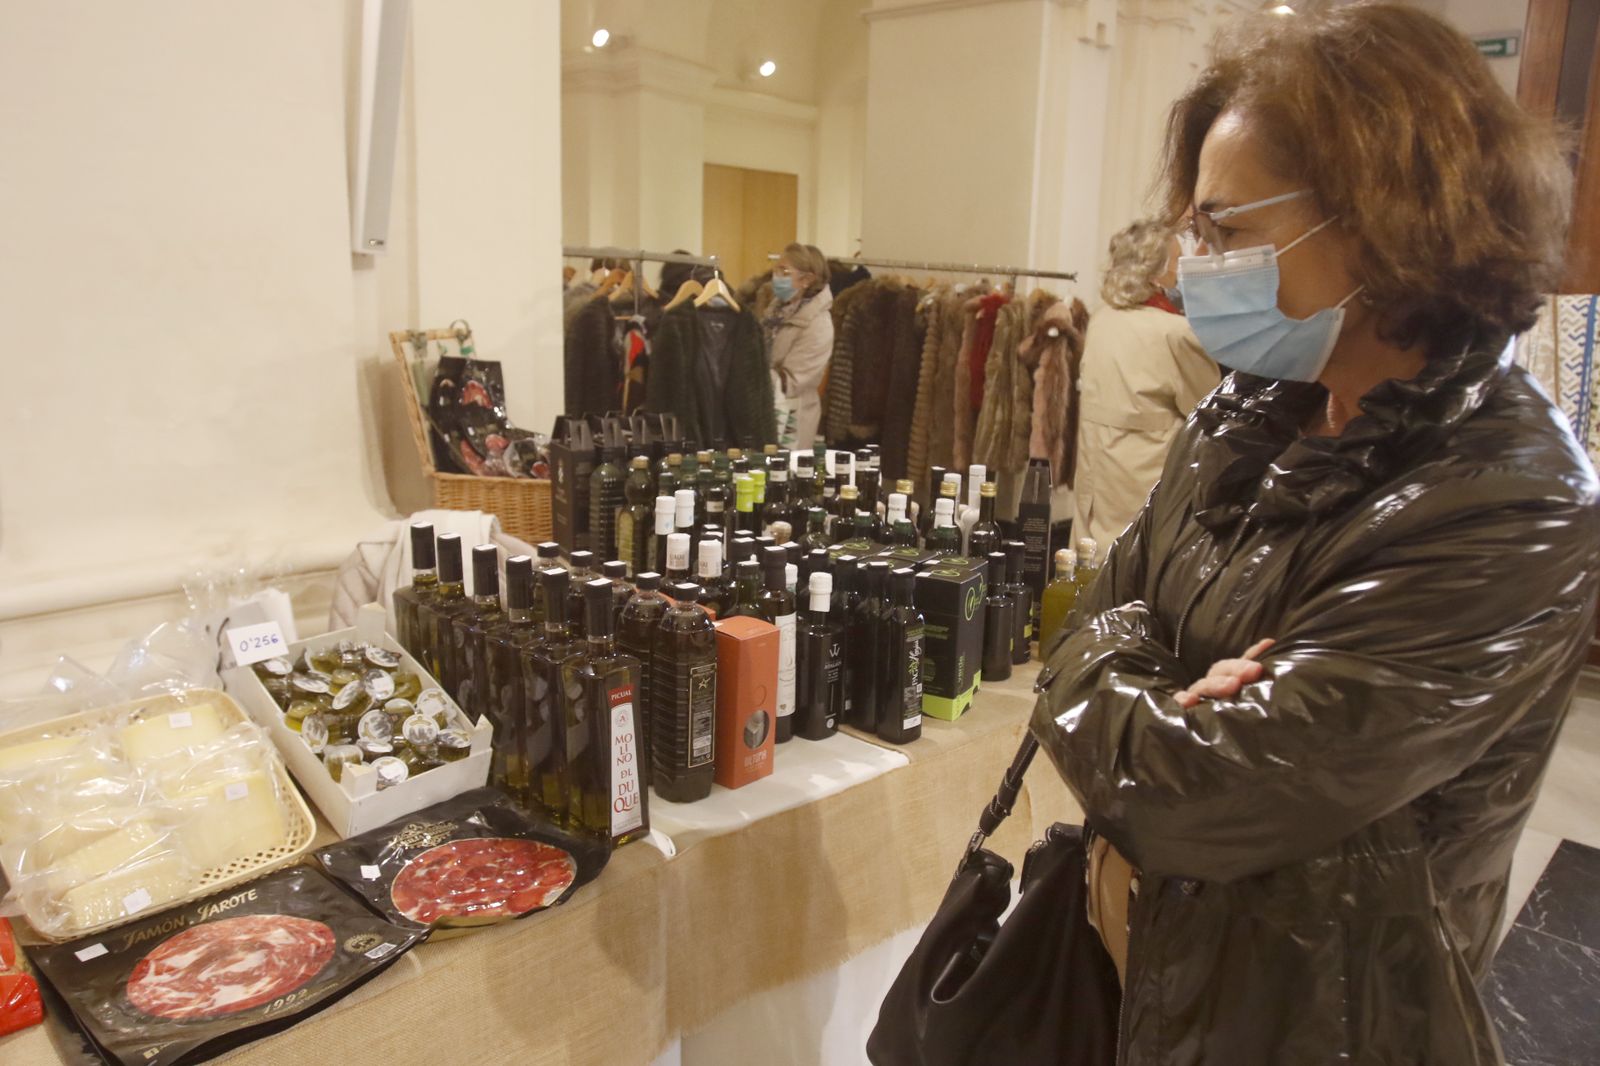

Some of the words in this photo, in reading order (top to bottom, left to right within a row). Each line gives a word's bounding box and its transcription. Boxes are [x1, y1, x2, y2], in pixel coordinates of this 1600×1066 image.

[611, 690, 632, 700] PICUAL
[615, 733, 633, 746] MO
[616, 752, 633, 766] NO
[618, 780, 635, 796] DU
[613, 791, 639, 813] QUE
